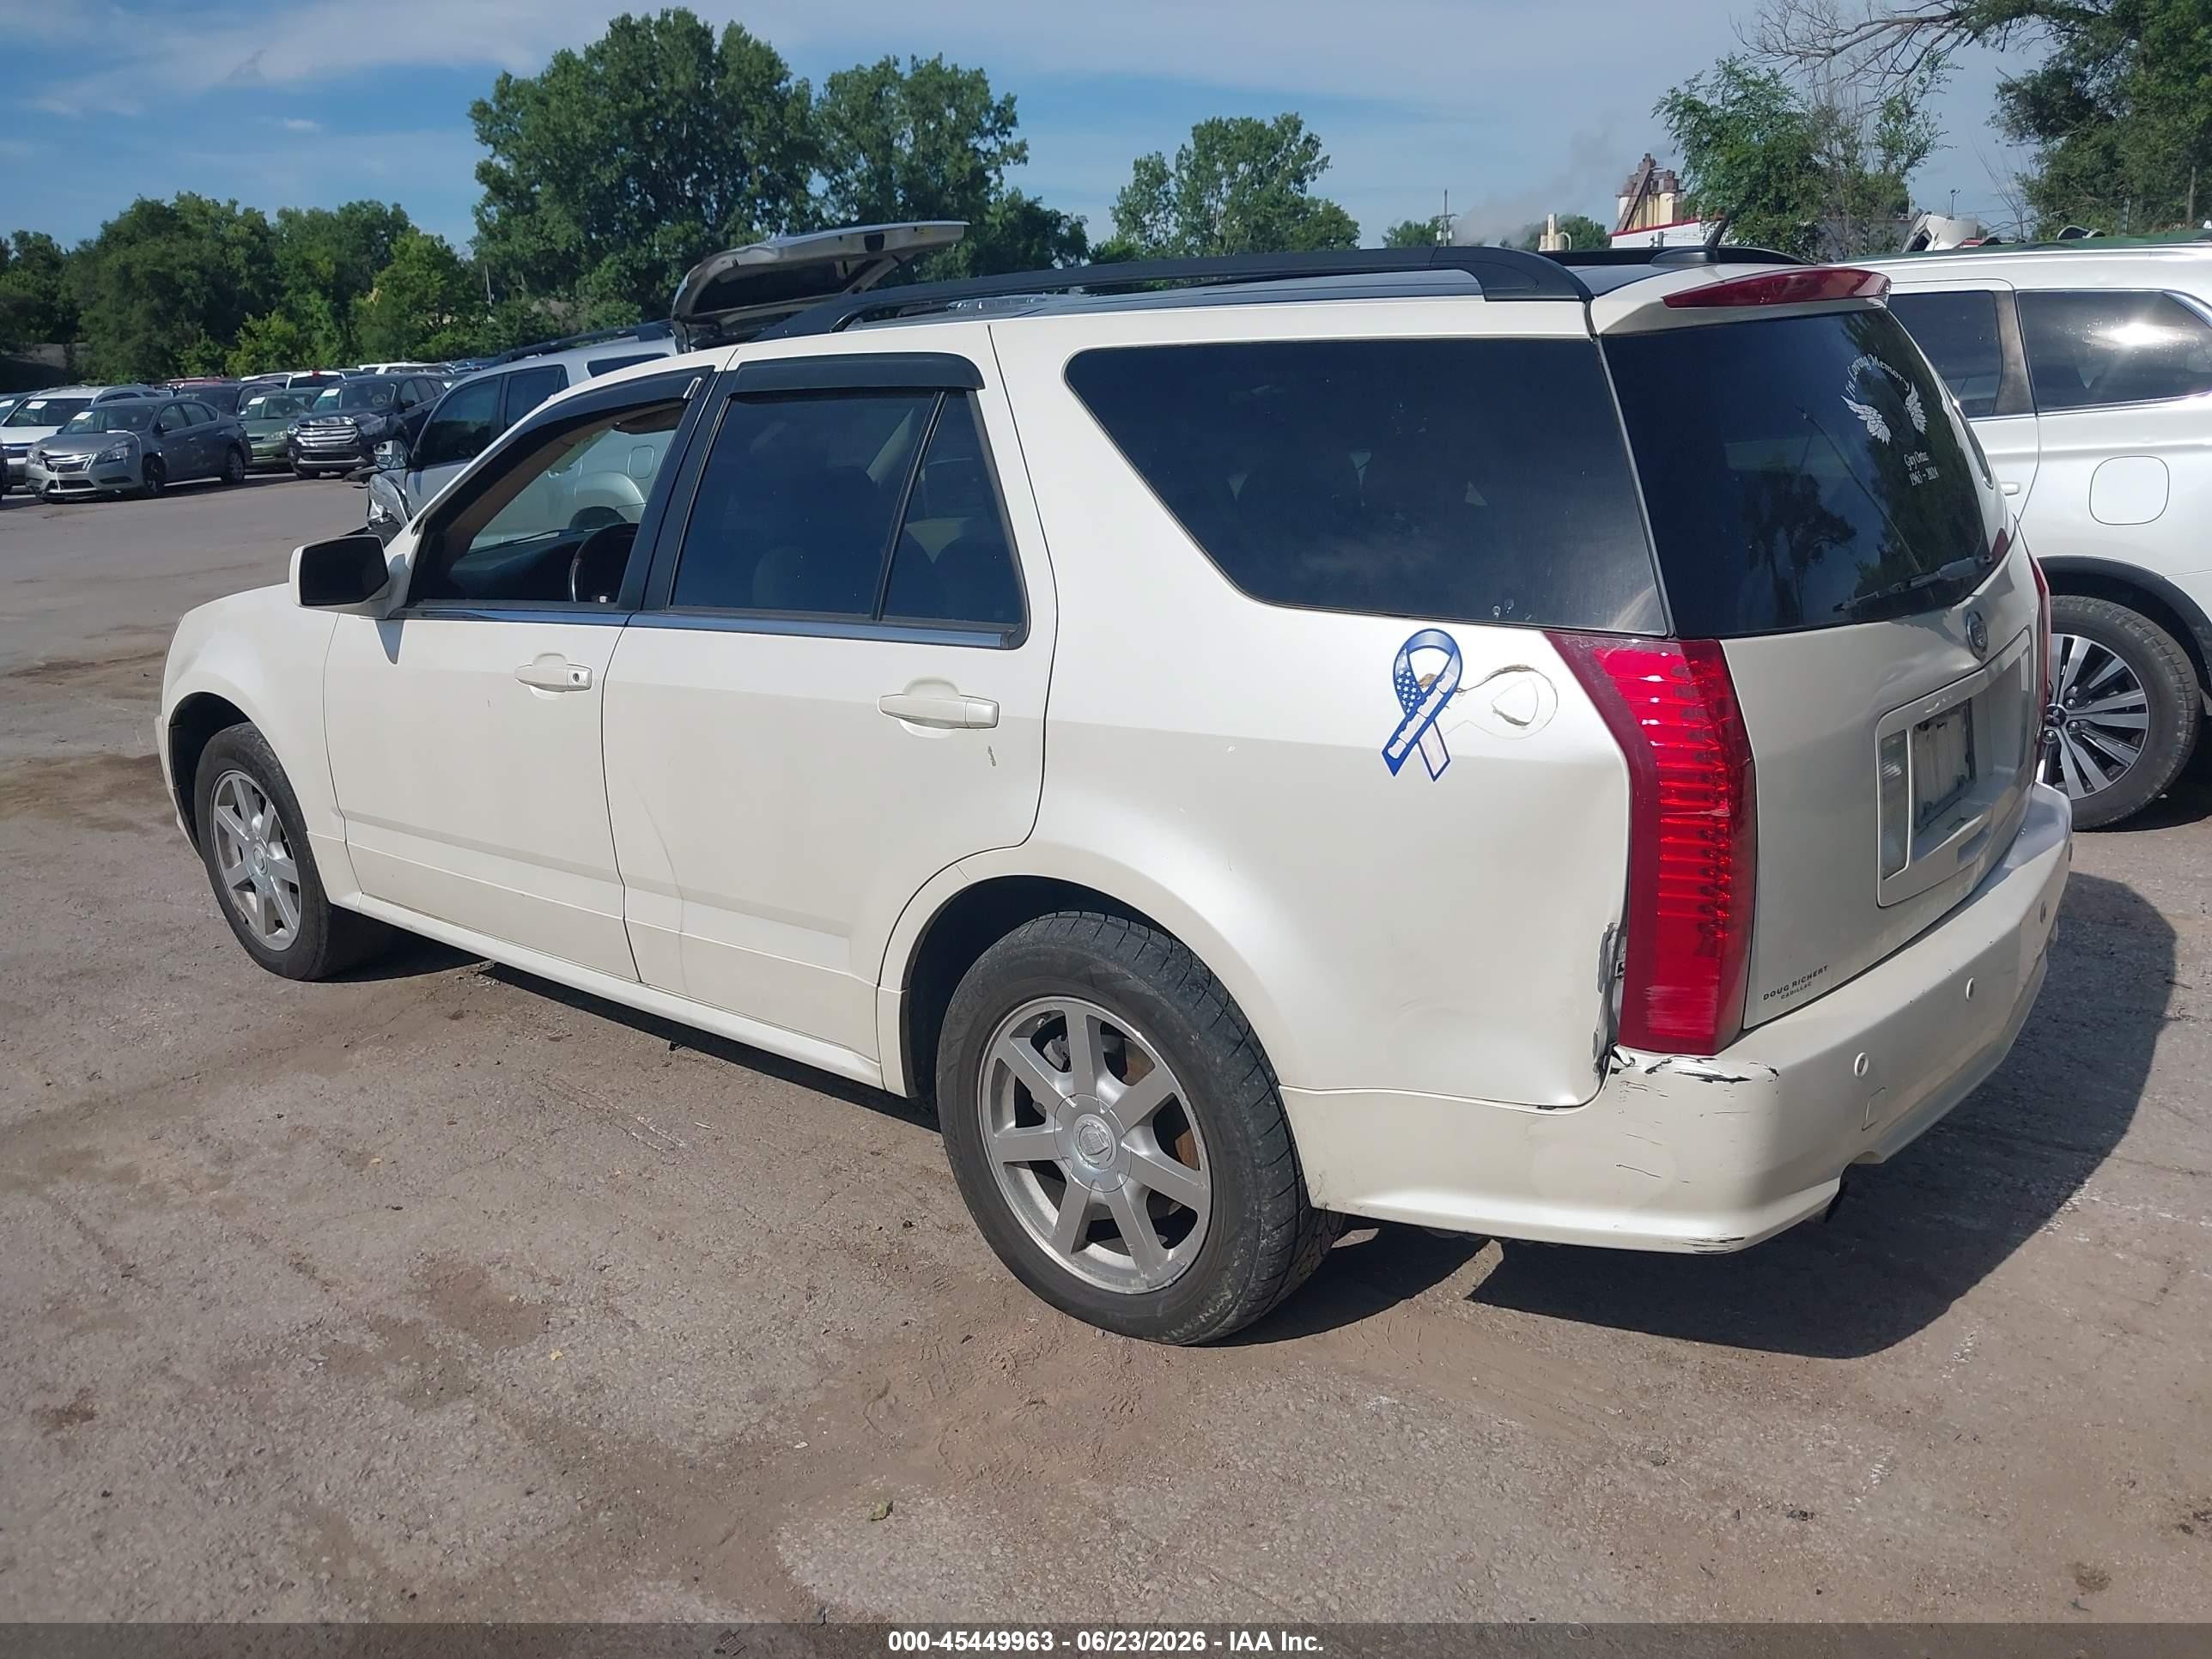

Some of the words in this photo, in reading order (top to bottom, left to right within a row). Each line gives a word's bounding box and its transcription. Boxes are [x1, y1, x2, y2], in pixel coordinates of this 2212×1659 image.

[1847, 356, 1871, 383] Loving
[1867, 353, 1910, 392] Memory
[1845, 380, 1856, 400] In
[1763, 984, 1790, 1000] DOUG
[1791, 964, 1828, 988] RICHERT
[1780, 981, 1812, 1000] CADILLAC
